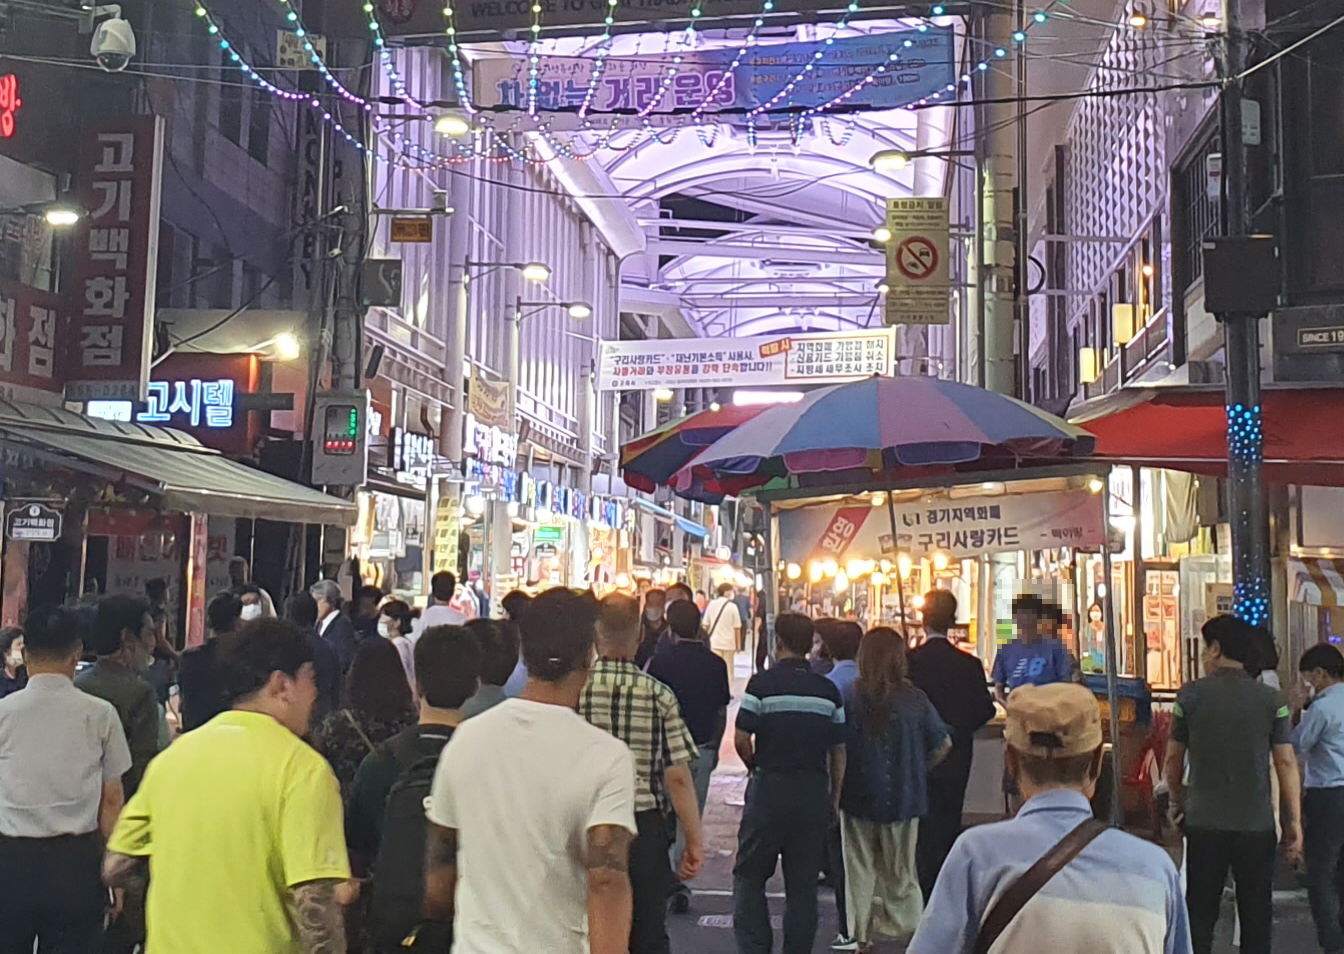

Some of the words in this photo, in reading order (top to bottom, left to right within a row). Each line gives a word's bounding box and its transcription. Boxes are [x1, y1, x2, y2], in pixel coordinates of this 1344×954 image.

[605, 76, 664, 109] 거리
[674, 71, 736, 108] 운영
[80, 133, 135, 366] 고기백화점
[1302, 332, 1329, 343] SINCE
[137, 379, 234, 427] 고시텔
[927, 505, 1001, 525] 경기지역화폐
[918, 526, 1020, 551] 구리사랑카드
